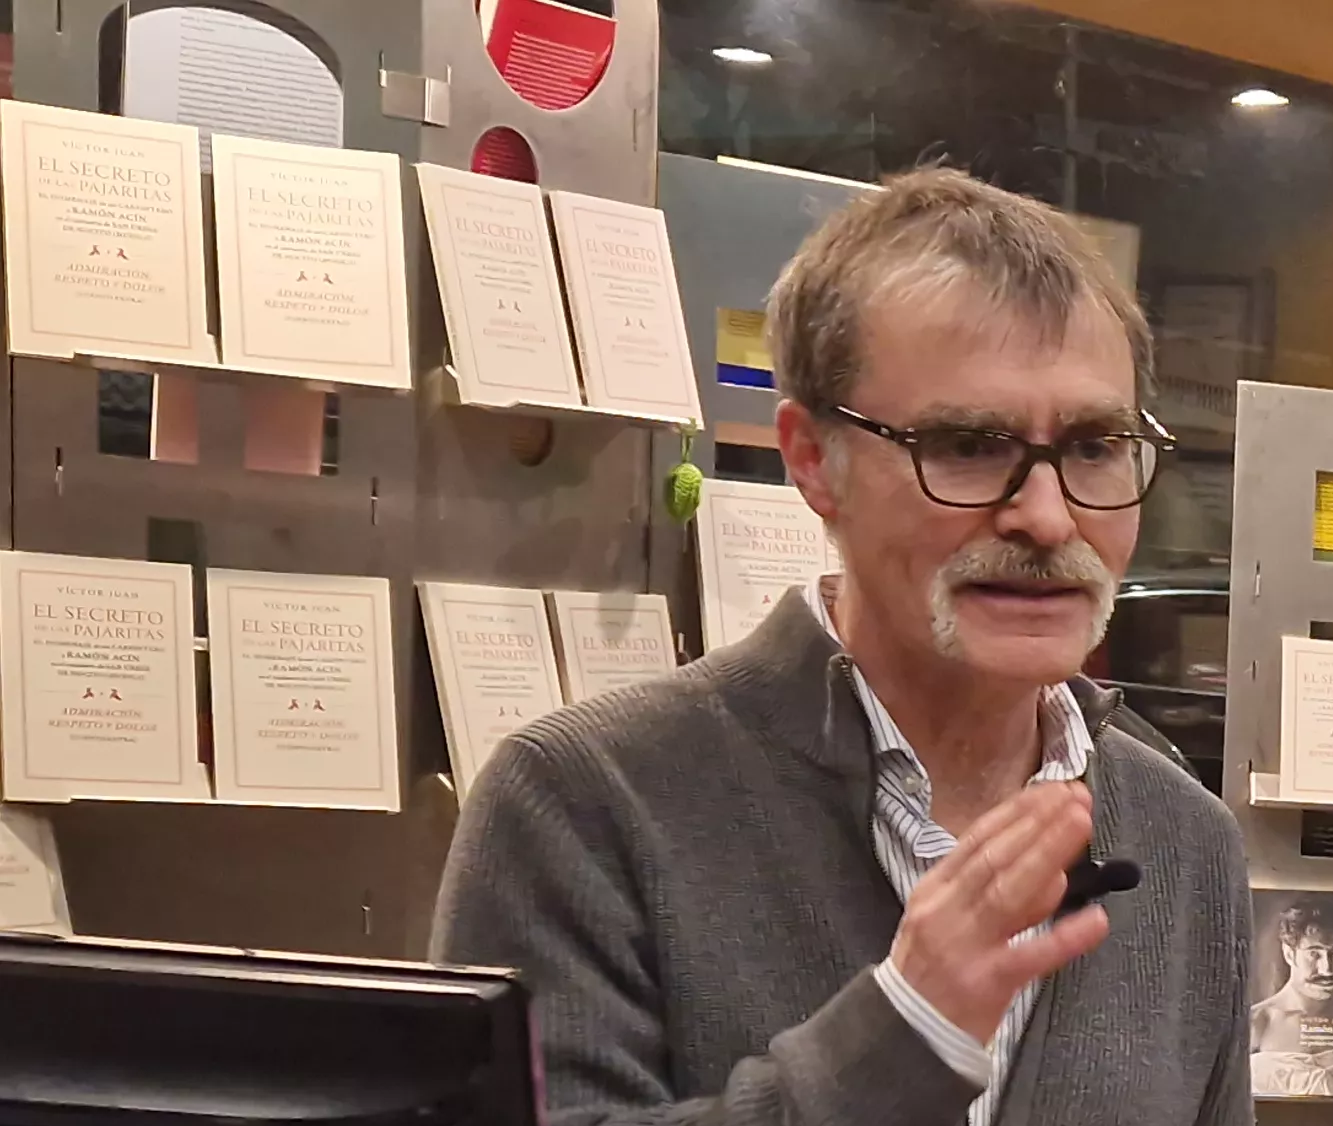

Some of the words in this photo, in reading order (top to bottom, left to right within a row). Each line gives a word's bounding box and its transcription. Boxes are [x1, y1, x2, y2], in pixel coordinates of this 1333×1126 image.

[38, 156, 63, 173] EL
[69, 160, 171, 187] SECRETO
[79, 179, 172, 202] PAJARITAS
[248, 187, 271, 202] EL
[278, 192, 373, 213] SECRETO
[287, 209, 374, 228] PAJARITAS
[473, 221, 534, 242] SECRETO
[602, 242, 658, 261] SECRETO
[722, 523, 741, 536] EL
[744, 525, 817, 542] SECRETO
[33, 603, 58, 620] EL
[64, 605, 164, 626] SECRETO
[73, 623, 165, 641] PAJARITAS
[241, 618, 266, 634] EL
[270, 619, 364, 638] SECRETO
[278, 638, 366, 653] PAJARITAS
[456, 631, 473, 644] EL
[475, 632, 534, 648] SECRETO
[1304, 673, 1318, 683] EL
[1300, 1024, 1333, 1033] Ramón
